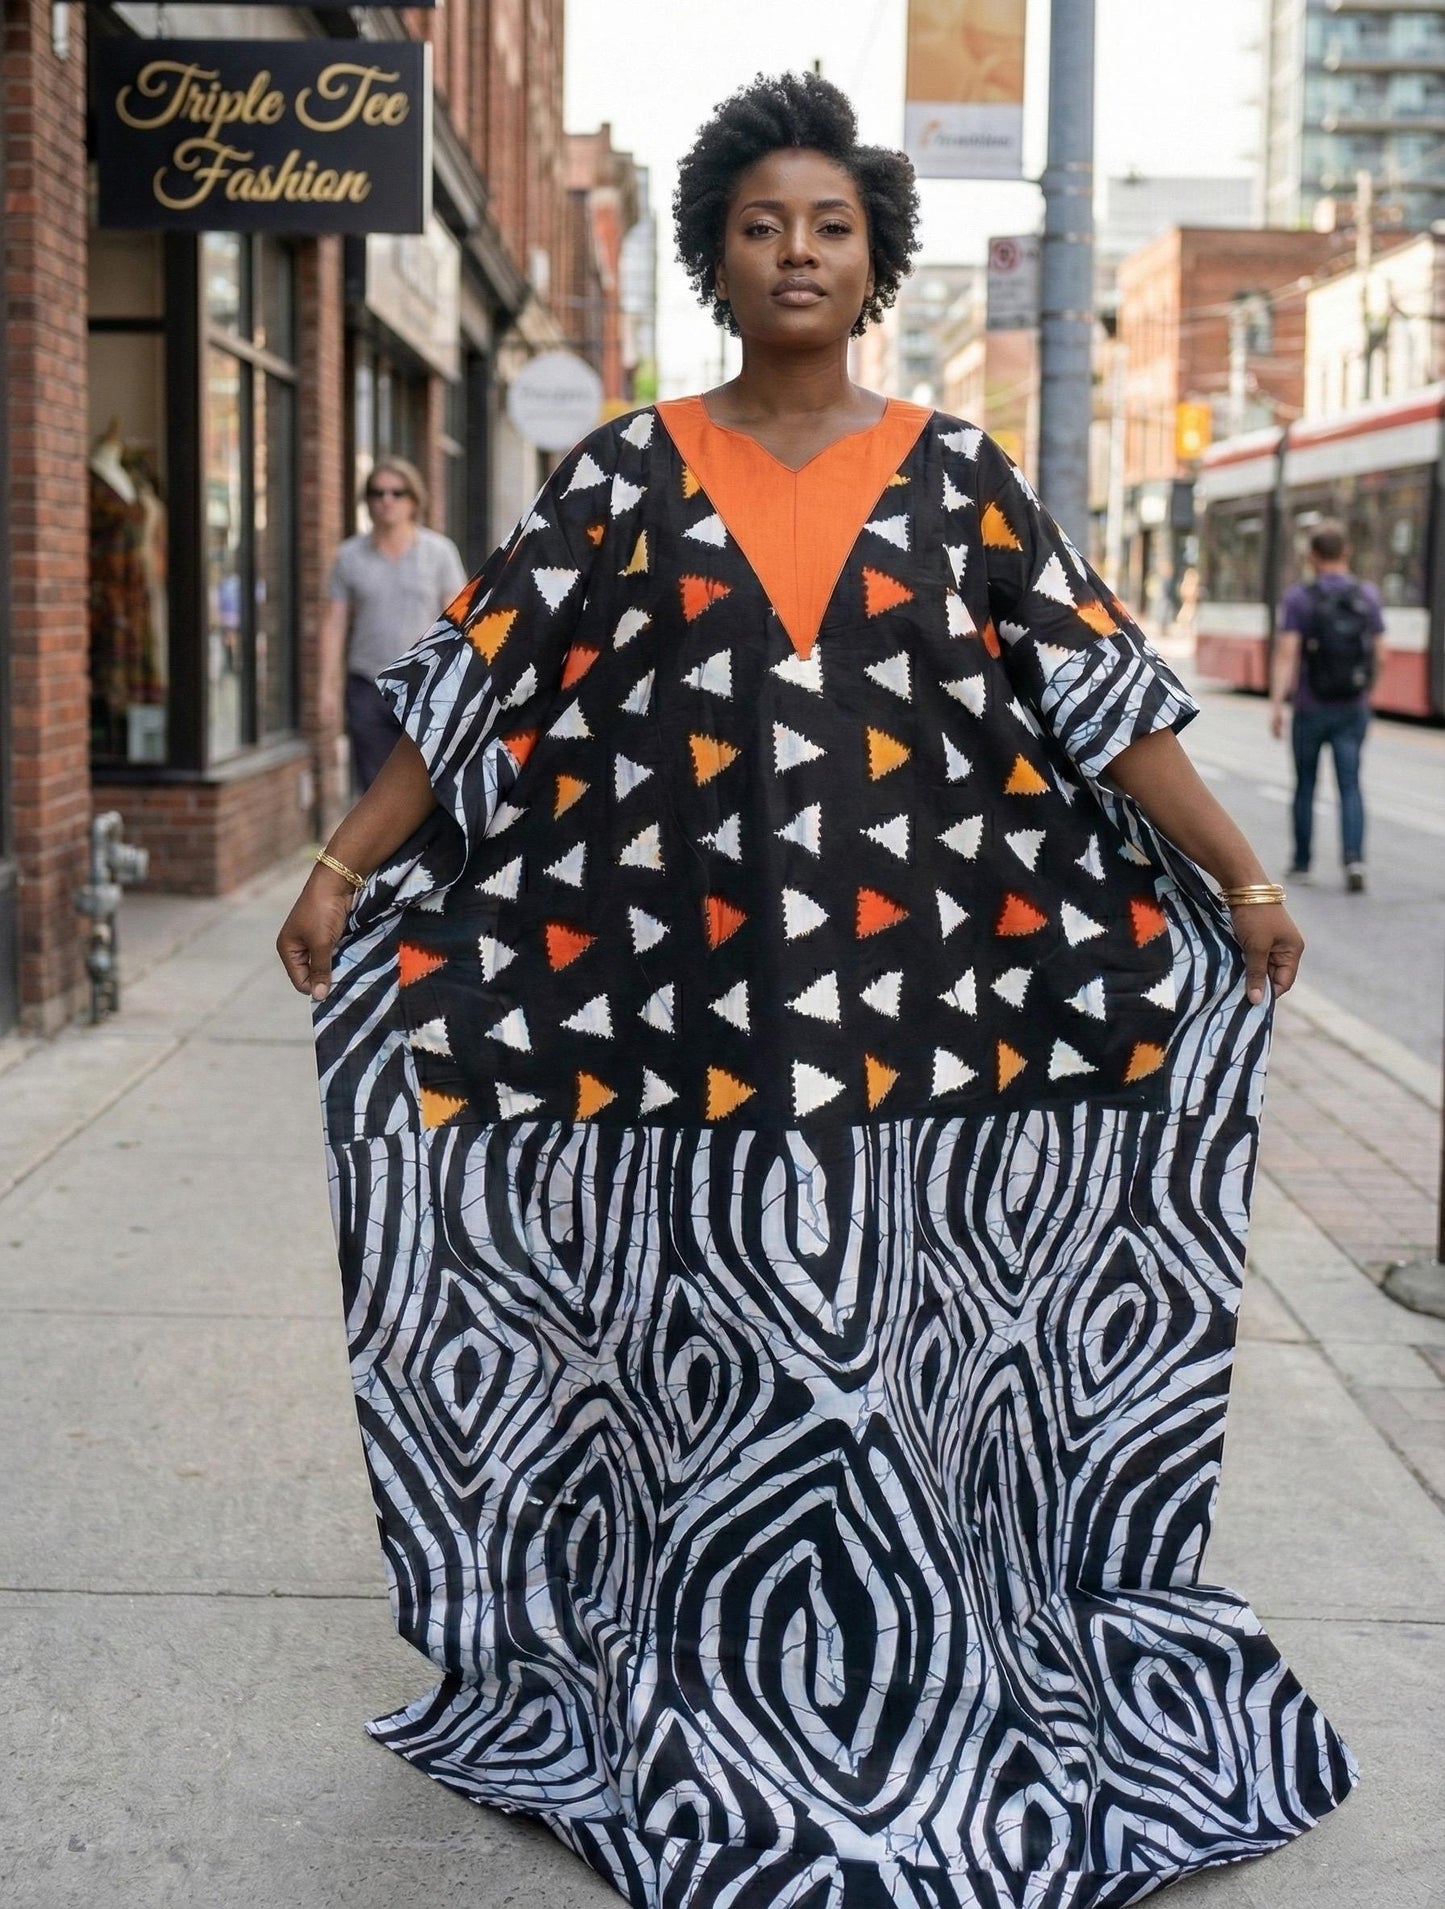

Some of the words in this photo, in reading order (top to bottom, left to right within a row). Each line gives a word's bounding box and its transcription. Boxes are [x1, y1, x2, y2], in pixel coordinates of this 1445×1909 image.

[115, 60, 286, 139] Triple
[295, 63, 409, 132] Tee
[153, 138, 372, 210] Fashion
